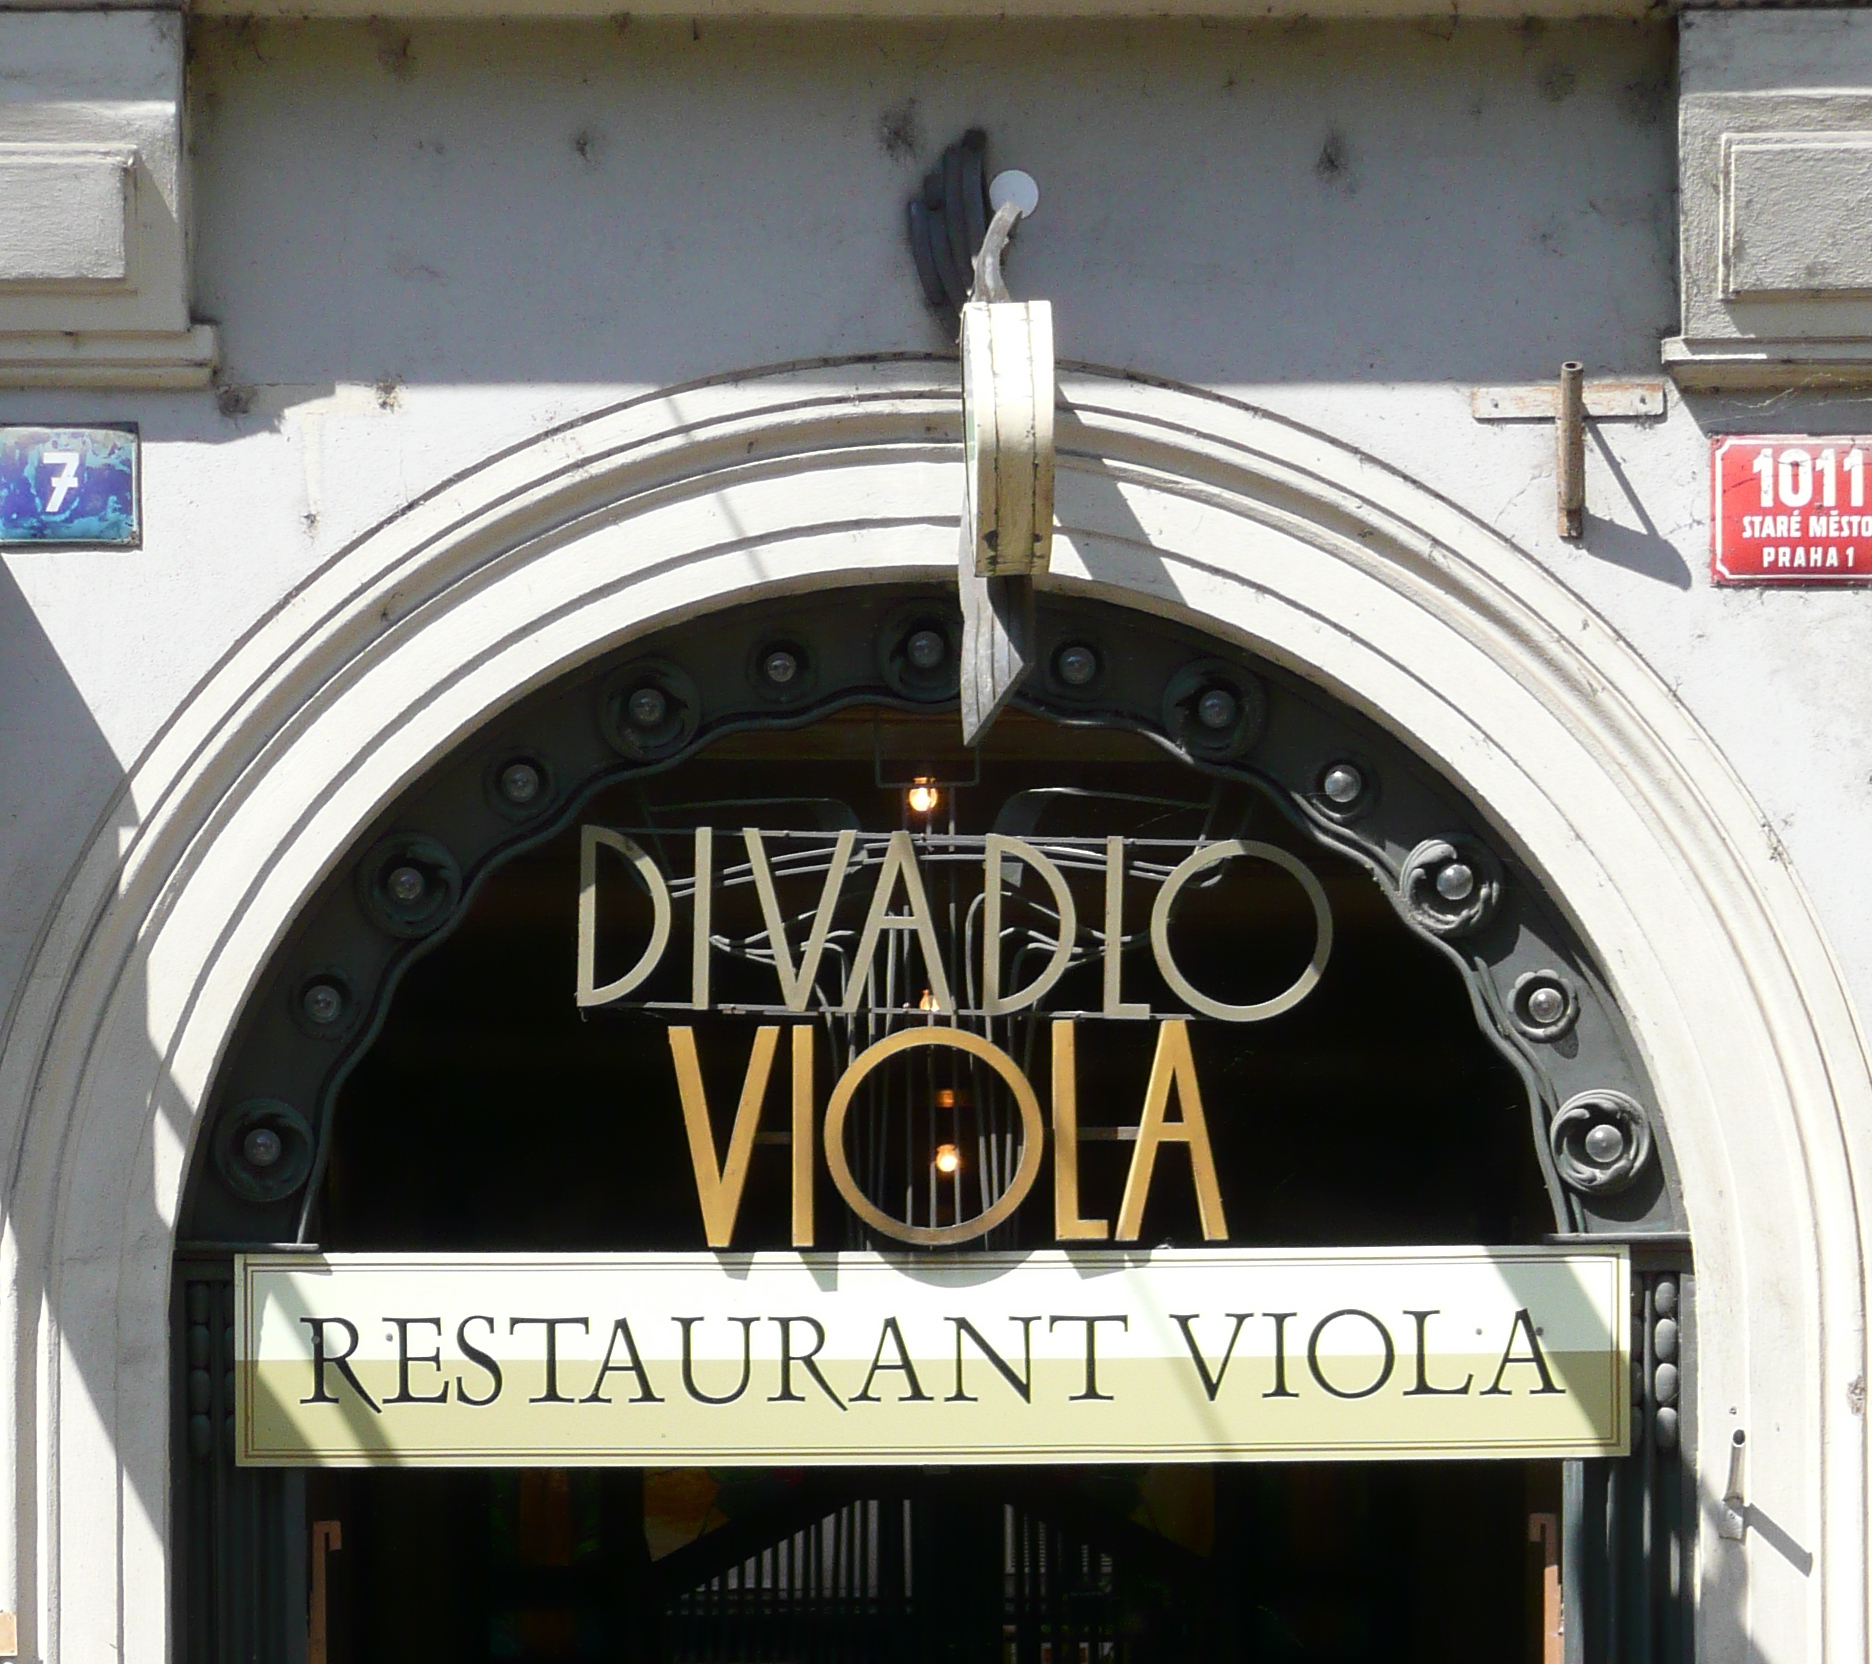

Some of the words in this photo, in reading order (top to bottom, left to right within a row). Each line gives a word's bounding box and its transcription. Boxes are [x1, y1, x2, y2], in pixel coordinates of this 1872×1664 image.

[43, 452, 80, 513] 7
[1752, 447, 1864, 508] 1011
[1742, 510, 1802, 538] STARÉ
[1762, 546, 1839, 568] PRAHA
[1845, 546, 1855, 568] 1
[576, 824, 1333, 1023] DIVADLO
[667, 1019, 1229, 1248] VIOLA
[299, 1314, 1129, 1414] RESTAURANT
[1168, 1307, 1567, 1402] VIOLA
